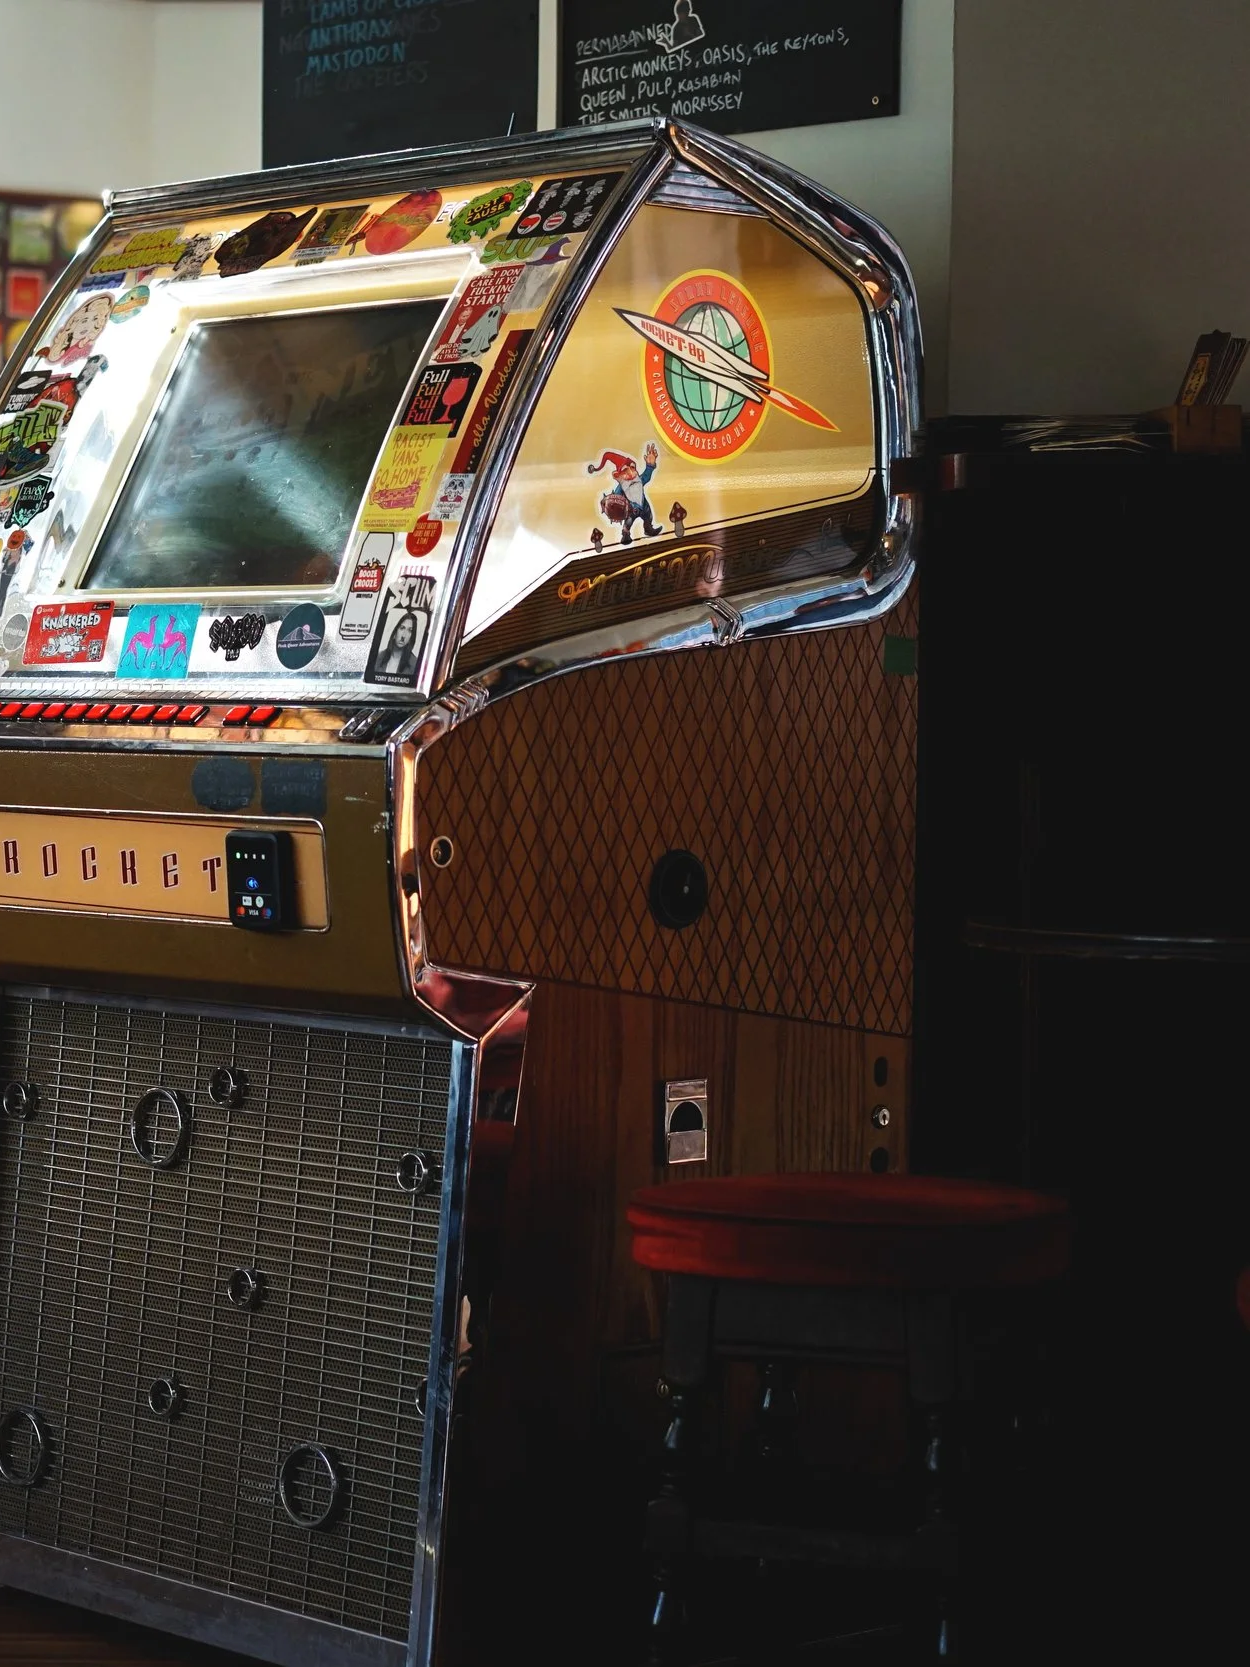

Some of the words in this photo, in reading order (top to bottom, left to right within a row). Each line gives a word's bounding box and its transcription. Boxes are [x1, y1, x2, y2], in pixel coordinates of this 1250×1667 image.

[307, 18, 393, 51] ANTHRAX
[305, 41, 407, 76] MASTODON
[581, 65, 628, 89] ARCTIC
[753, 42, 779, 57] THE
[677, 69, 742, 93] KASABIAN
[671, 91, 743, 117] MORRISSEY
[464, 202, 506, 225] CAUSE
[468, 198, 501, 217] LOST
[471, 278, 495, 288] CARE
[495, 277, 504, 285] IF
[421, 368, 450, 384] Full
[416, 383, 445, 397] Full
[411, 396, 439, 410] Full
[406, 409, 434, 423] Full
[393, 432, 436, 450] RACIST
[391, 450, 423, 467] VANS
[359, 569, 378, 578] BOOZE
[42, 611, 101, 630] KNACKERED
[387, 676, 410, 684] BASTARD
[2, 839, 222, 896] ROCKET
